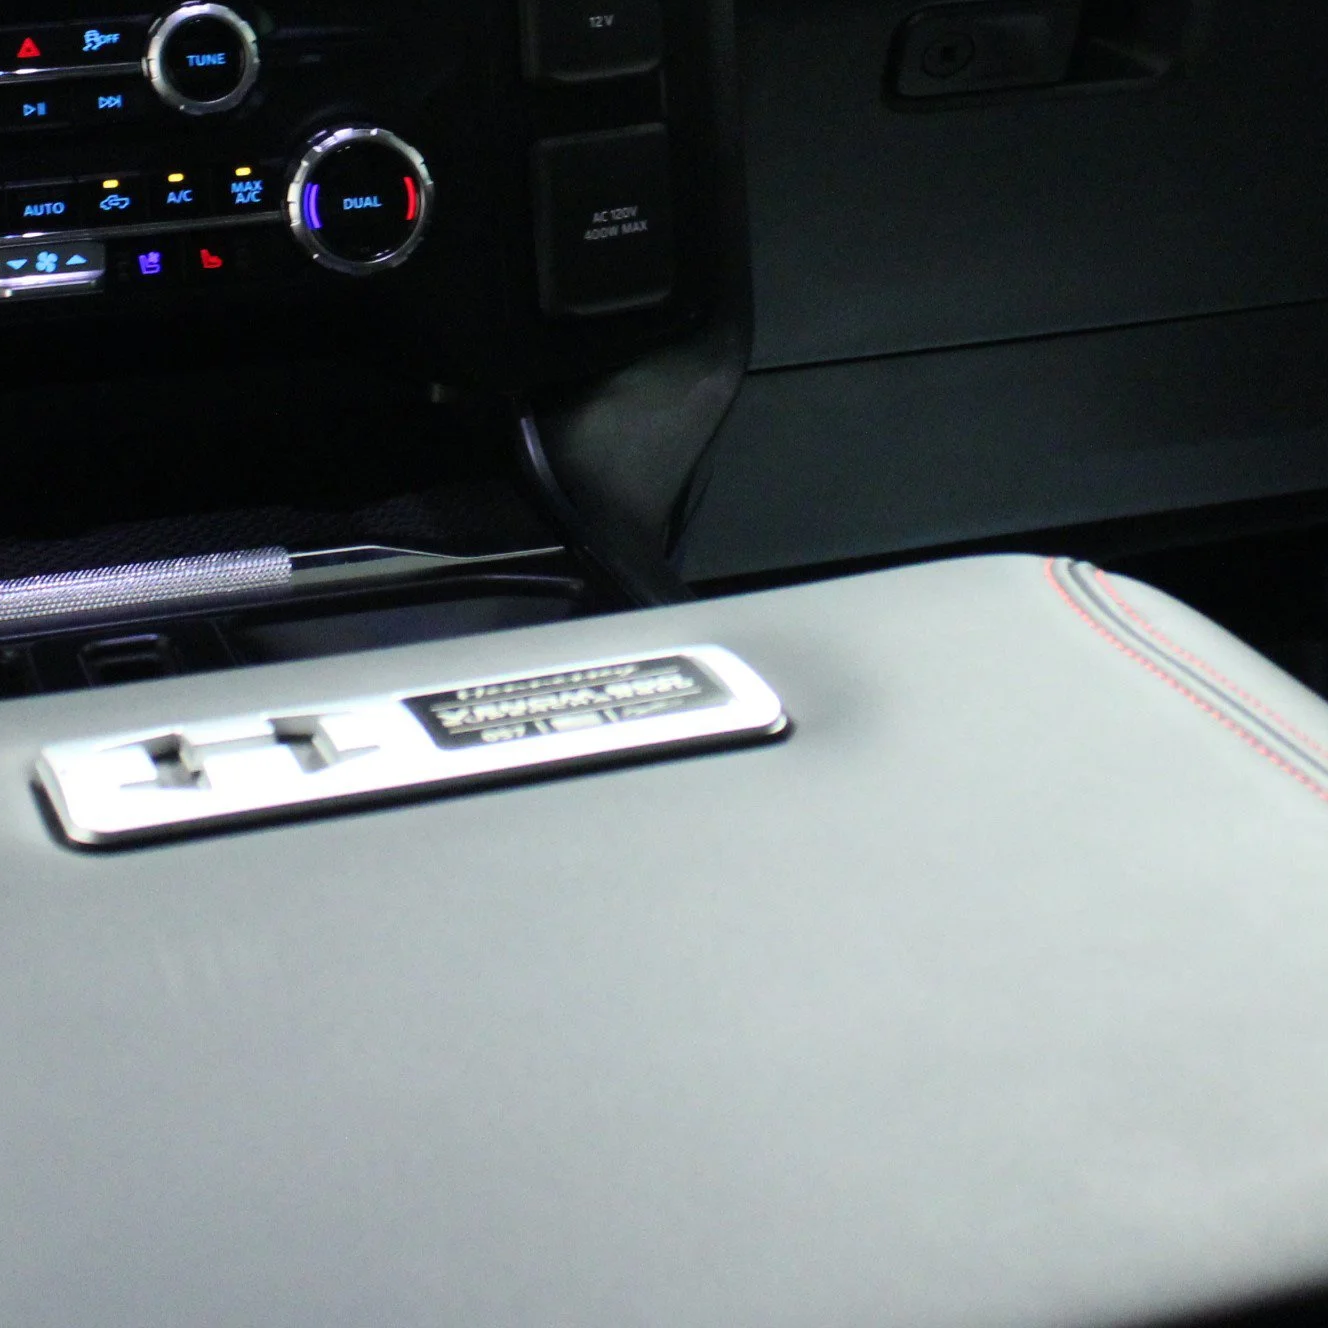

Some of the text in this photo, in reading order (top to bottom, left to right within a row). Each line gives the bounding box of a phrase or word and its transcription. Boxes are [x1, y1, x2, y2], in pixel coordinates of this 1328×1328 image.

[186, 52, 227, 67] TUNE
[231, 179, 263, 193] MAX
[166, 189, 193, 204] A/C
[235, 191, 261, 204] A/C
[342, 195, 382, 210] DUAL
[23, 201, 66, 217] AUTO
[621, 220, 648, 235] MAX
